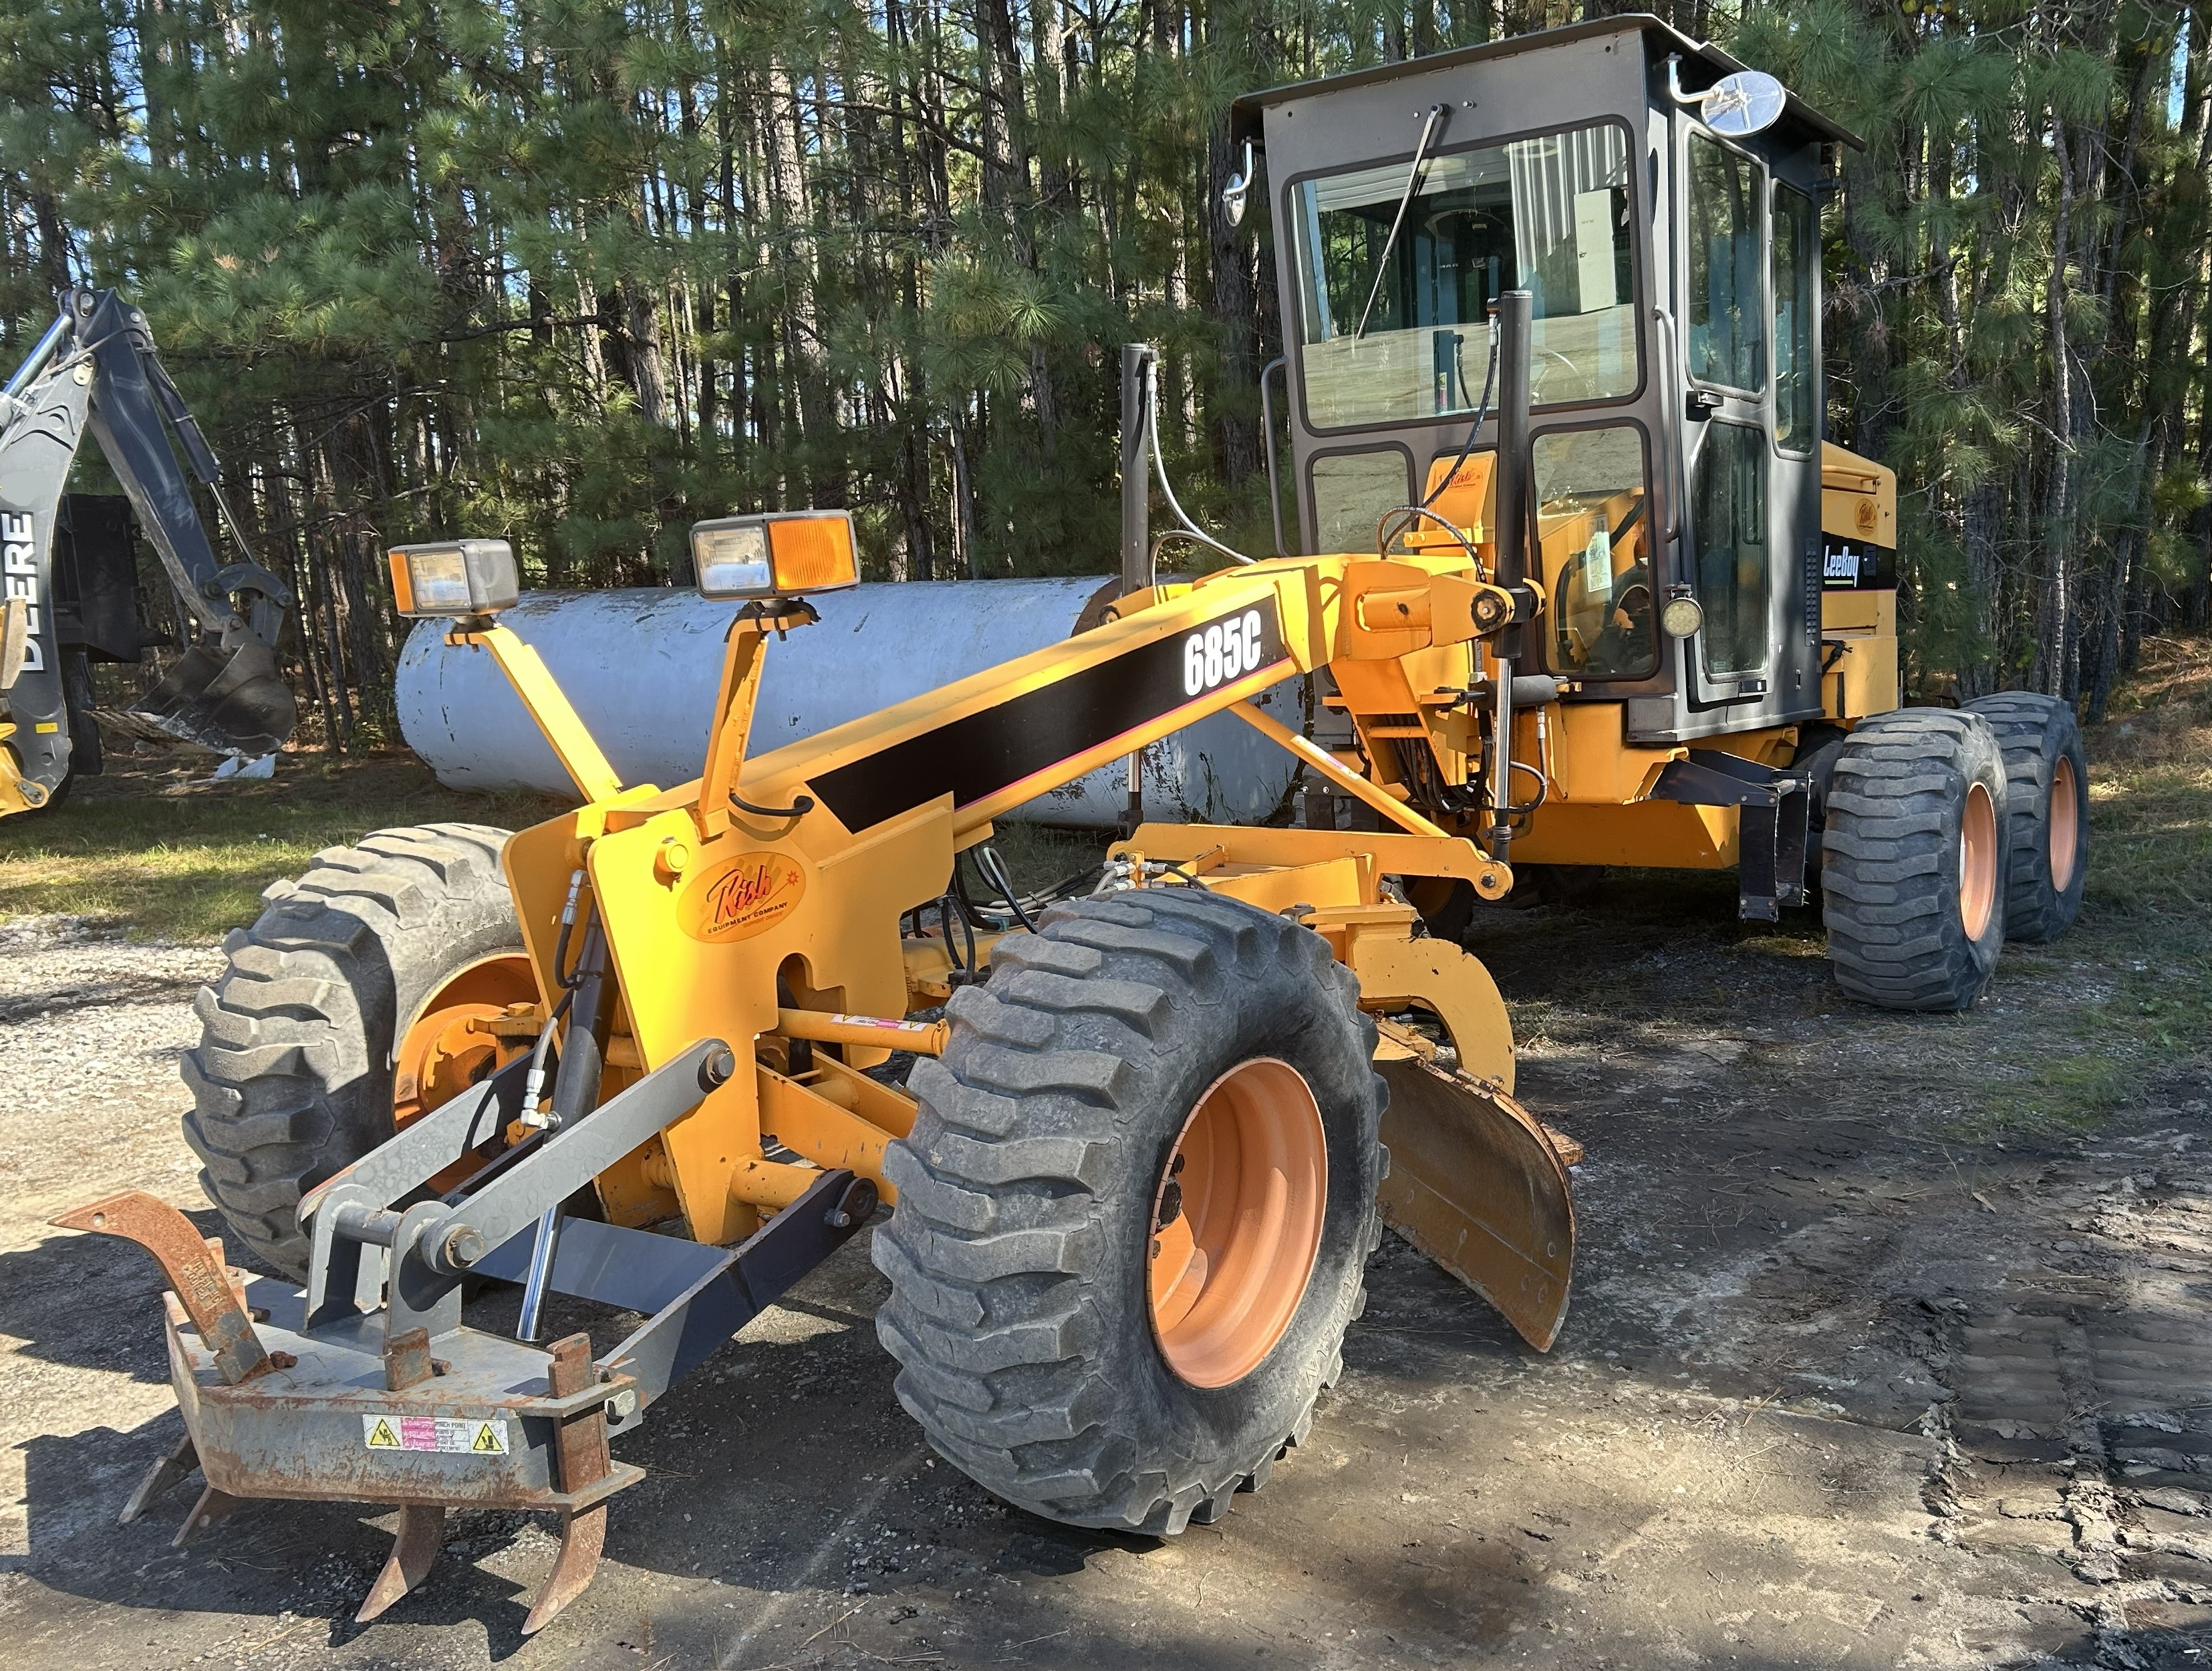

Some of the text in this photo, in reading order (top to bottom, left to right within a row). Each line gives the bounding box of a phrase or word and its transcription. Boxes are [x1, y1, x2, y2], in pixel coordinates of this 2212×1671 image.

[1823, 545, 1860, 588] LeeBoy
[1184, 610, 1262, 696] 685C
[706, 864, 772, 924] Rish
[707, 901, 789, 934] EQUIPMENT COMPANY
